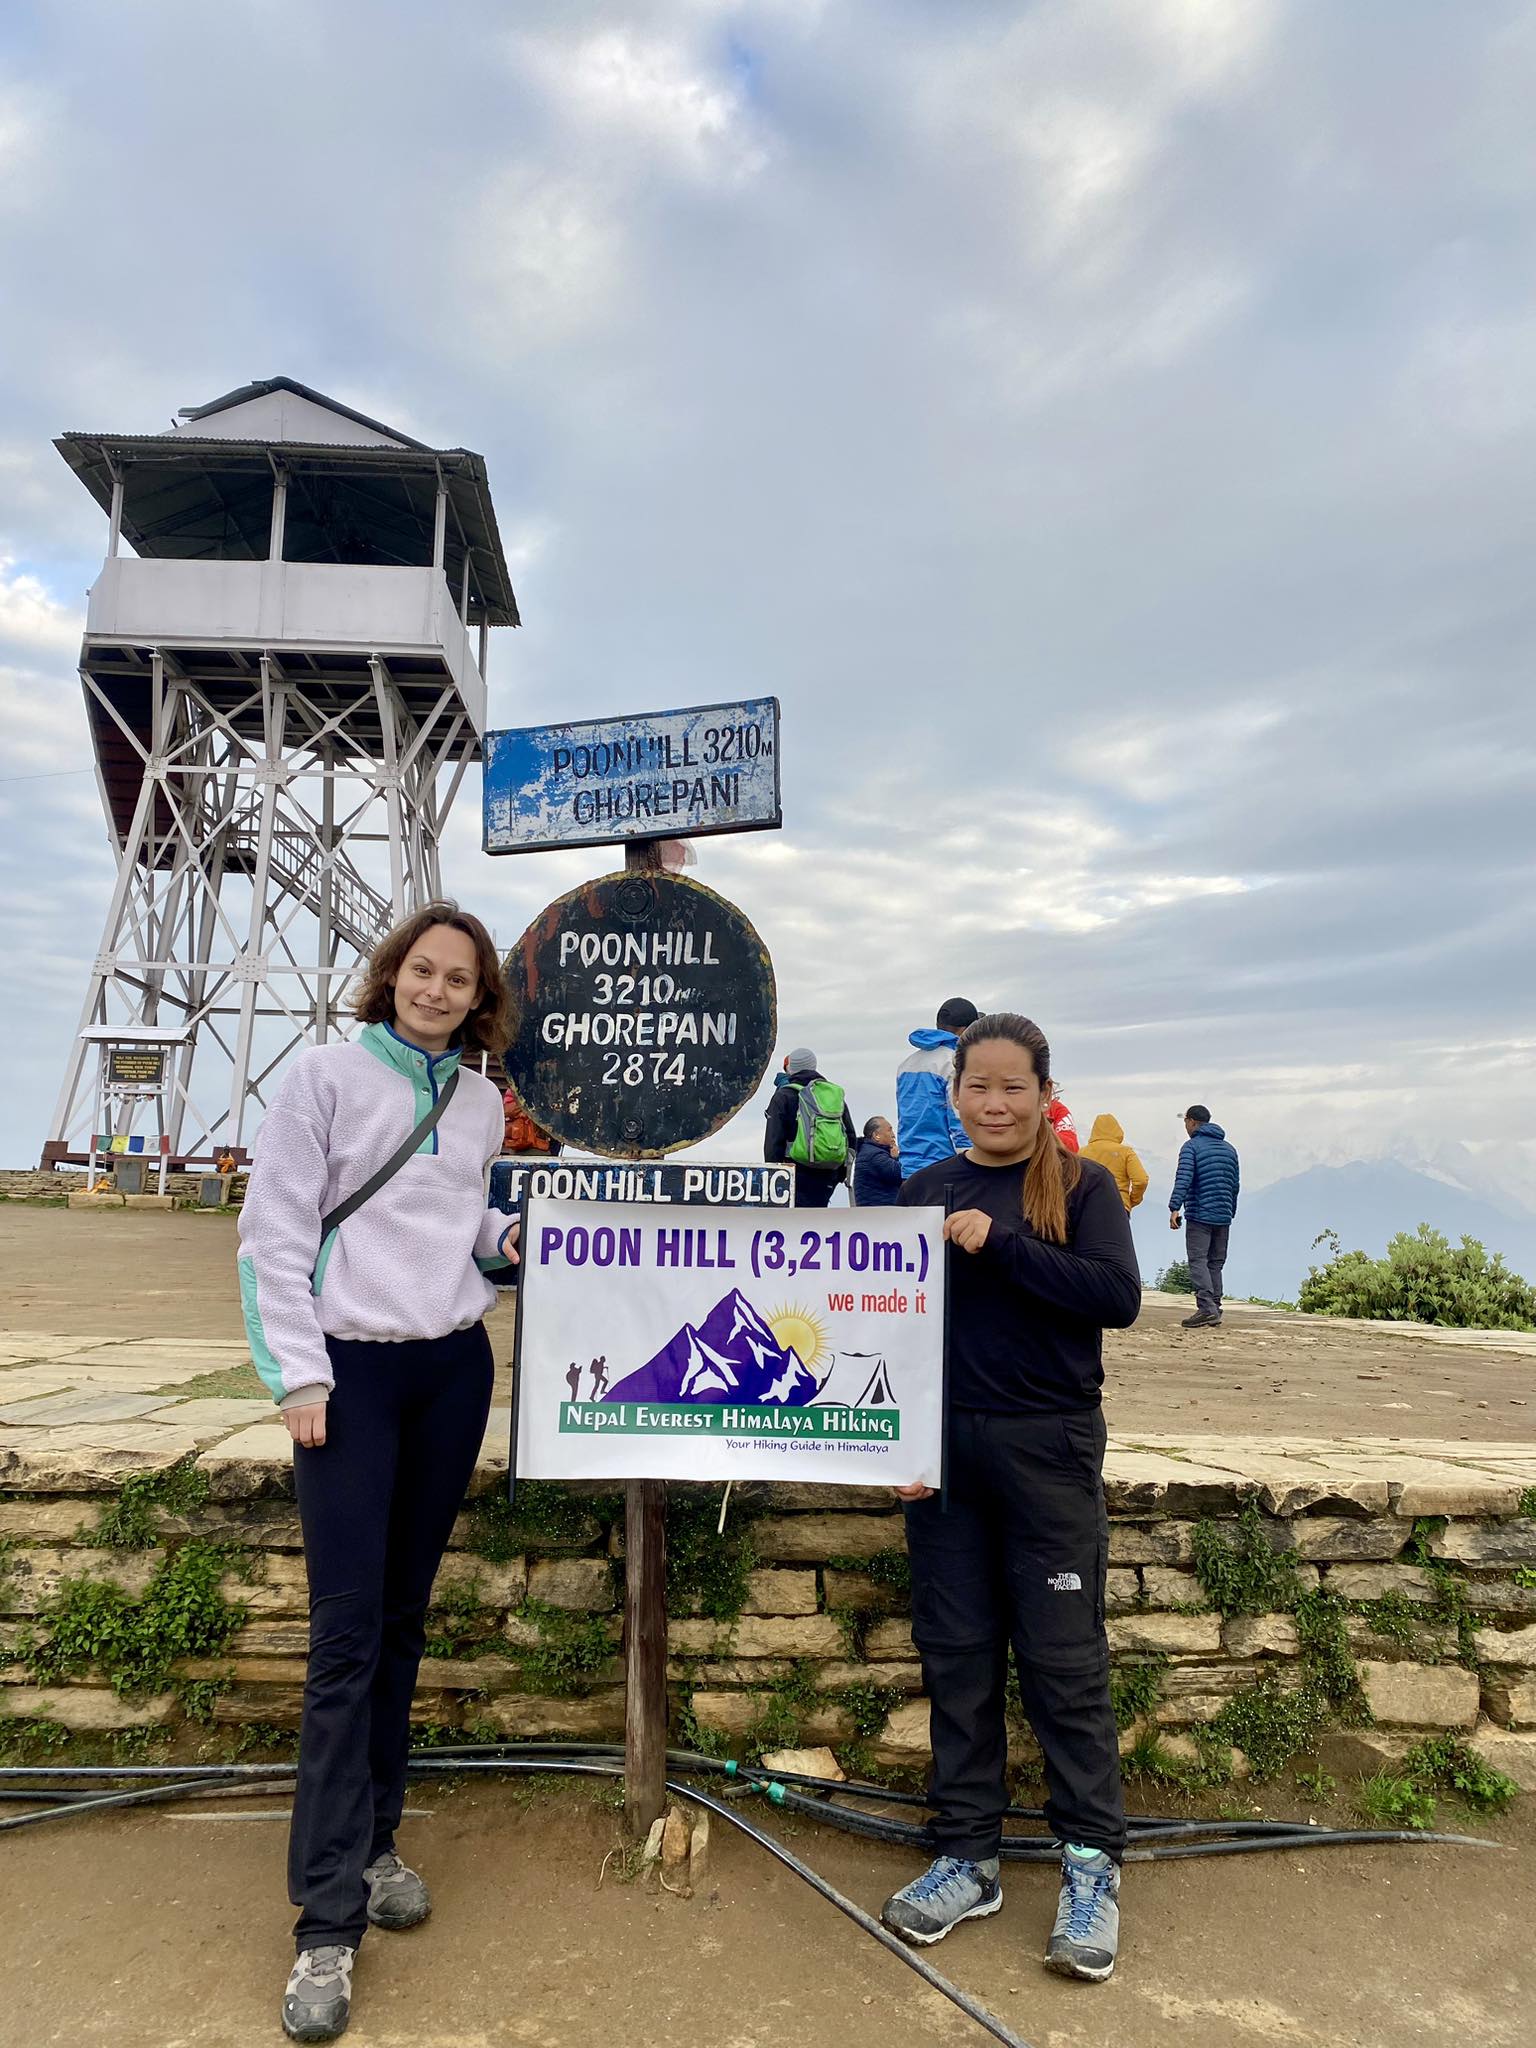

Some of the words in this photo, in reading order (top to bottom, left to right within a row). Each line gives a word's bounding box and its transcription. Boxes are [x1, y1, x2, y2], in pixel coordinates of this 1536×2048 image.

[573, 772, 740, 826] GHOREPANI
[559, 930, 720, 968] POONHILL
[541, 1011, 737, 1050] GHOREPANI
[601, 1052, 686, 1087] 2874
[683, 1169, 790, 1204] PUBLIC
[540, 1226, 642, 1267] POON
[656, 1228, 736, 1269] HILL
[750, 1230, 930, 1283] (3,210m.)
[827, 1291, 855, 1313] we
[861, 1288, 908, 1314] made
[915, 1288, 927, 1315] it
[726, 1438, 751, 1450] Your
[753, 1439, 788, 1453] Hiking
[790, 1440, 822, 1452] Guide
[824, 1441, 835, 1452] in
[837, 1441, 890, 1454] Himalaya
